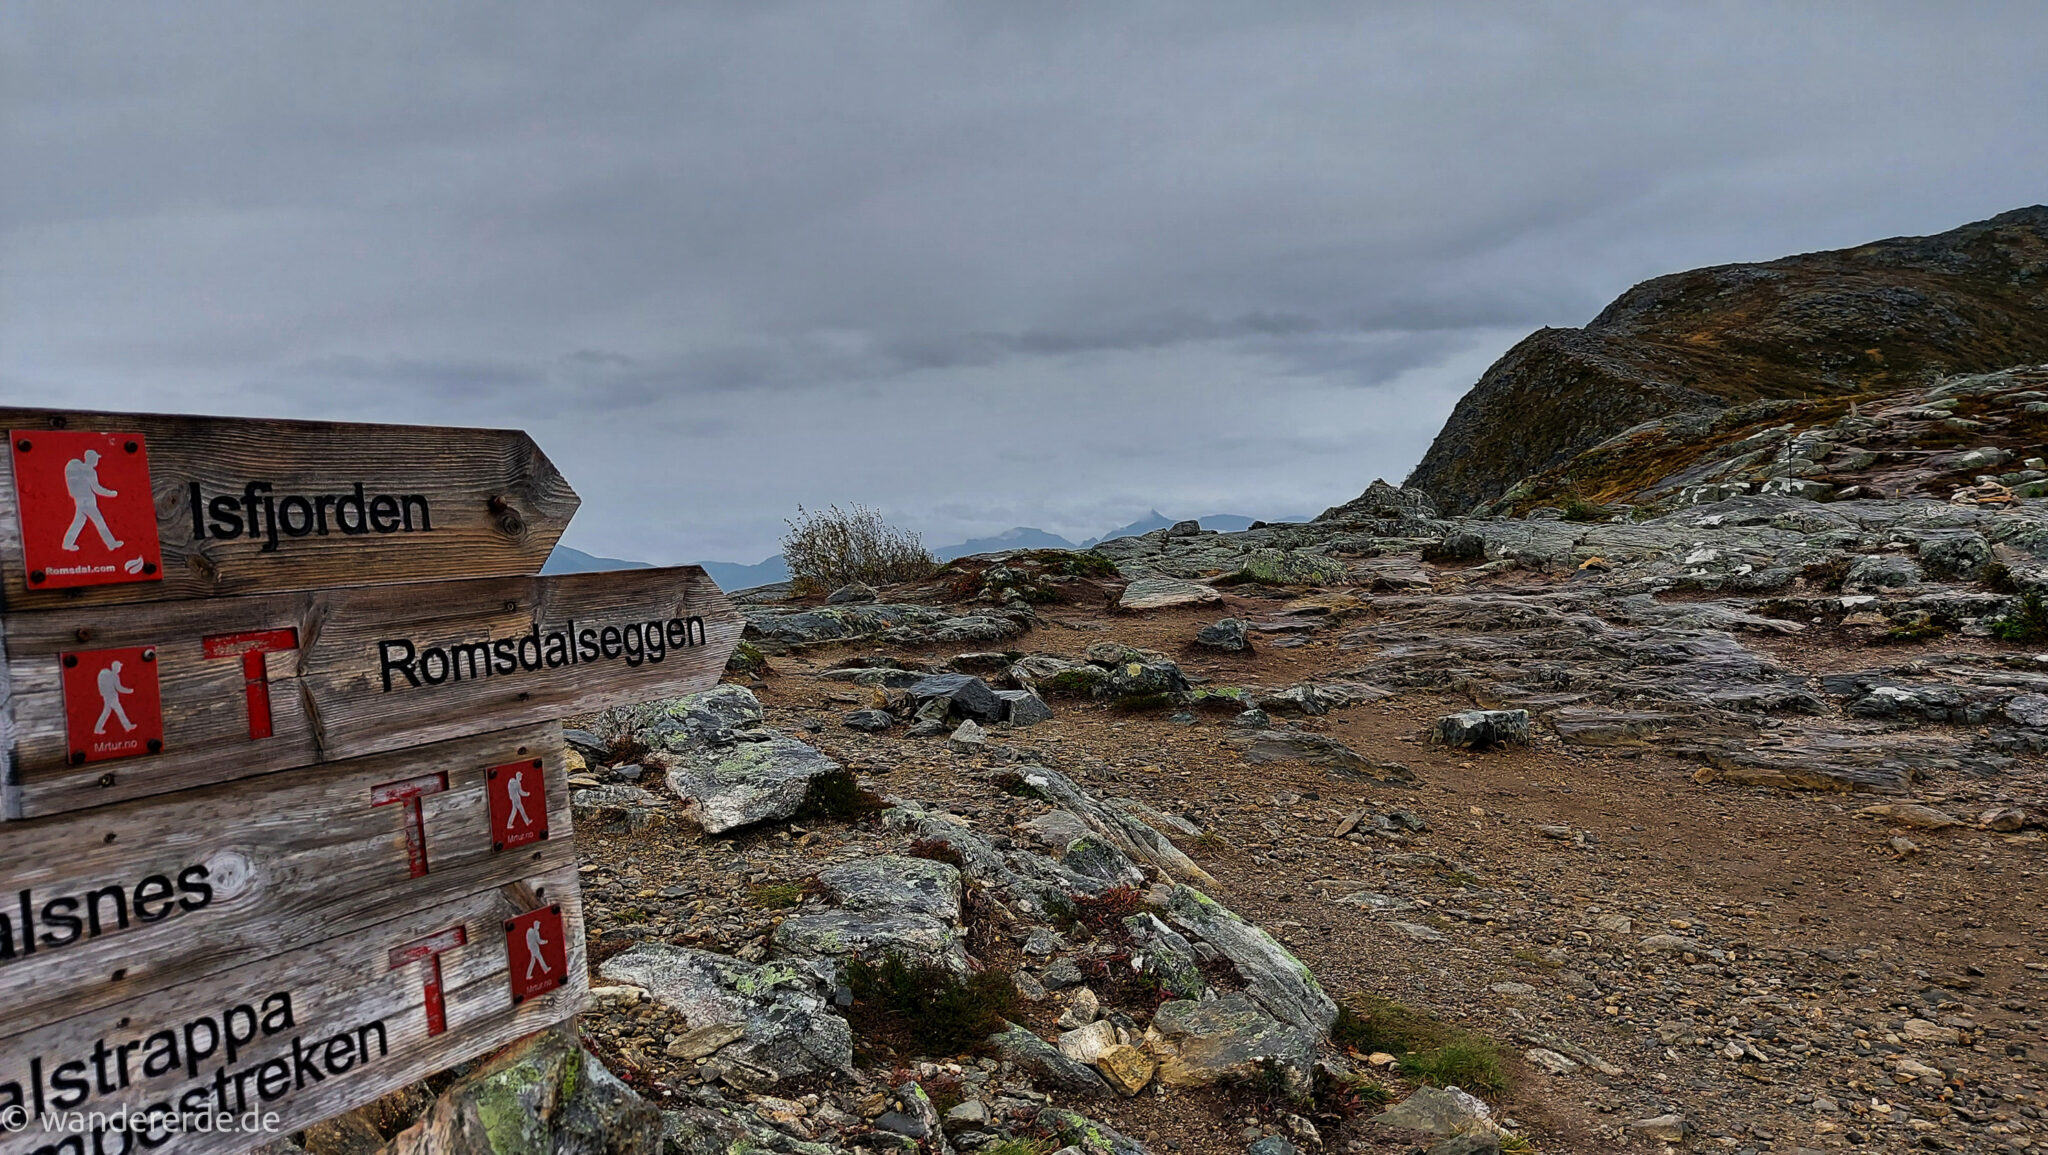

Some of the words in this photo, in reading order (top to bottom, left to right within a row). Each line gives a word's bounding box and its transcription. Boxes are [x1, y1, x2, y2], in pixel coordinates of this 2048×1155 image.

[189, 481, 432, 553] Isfjorden
[45, 565, 116, 576] Romsdal.com
[203, 627, 299, 740] T
[378, 615, 707, 693] Romsdalseggen
[94, 740, 138, 753] Mrtur.no
[370, 770, 449, 878] T
[388, 924, 467, 1037] T
